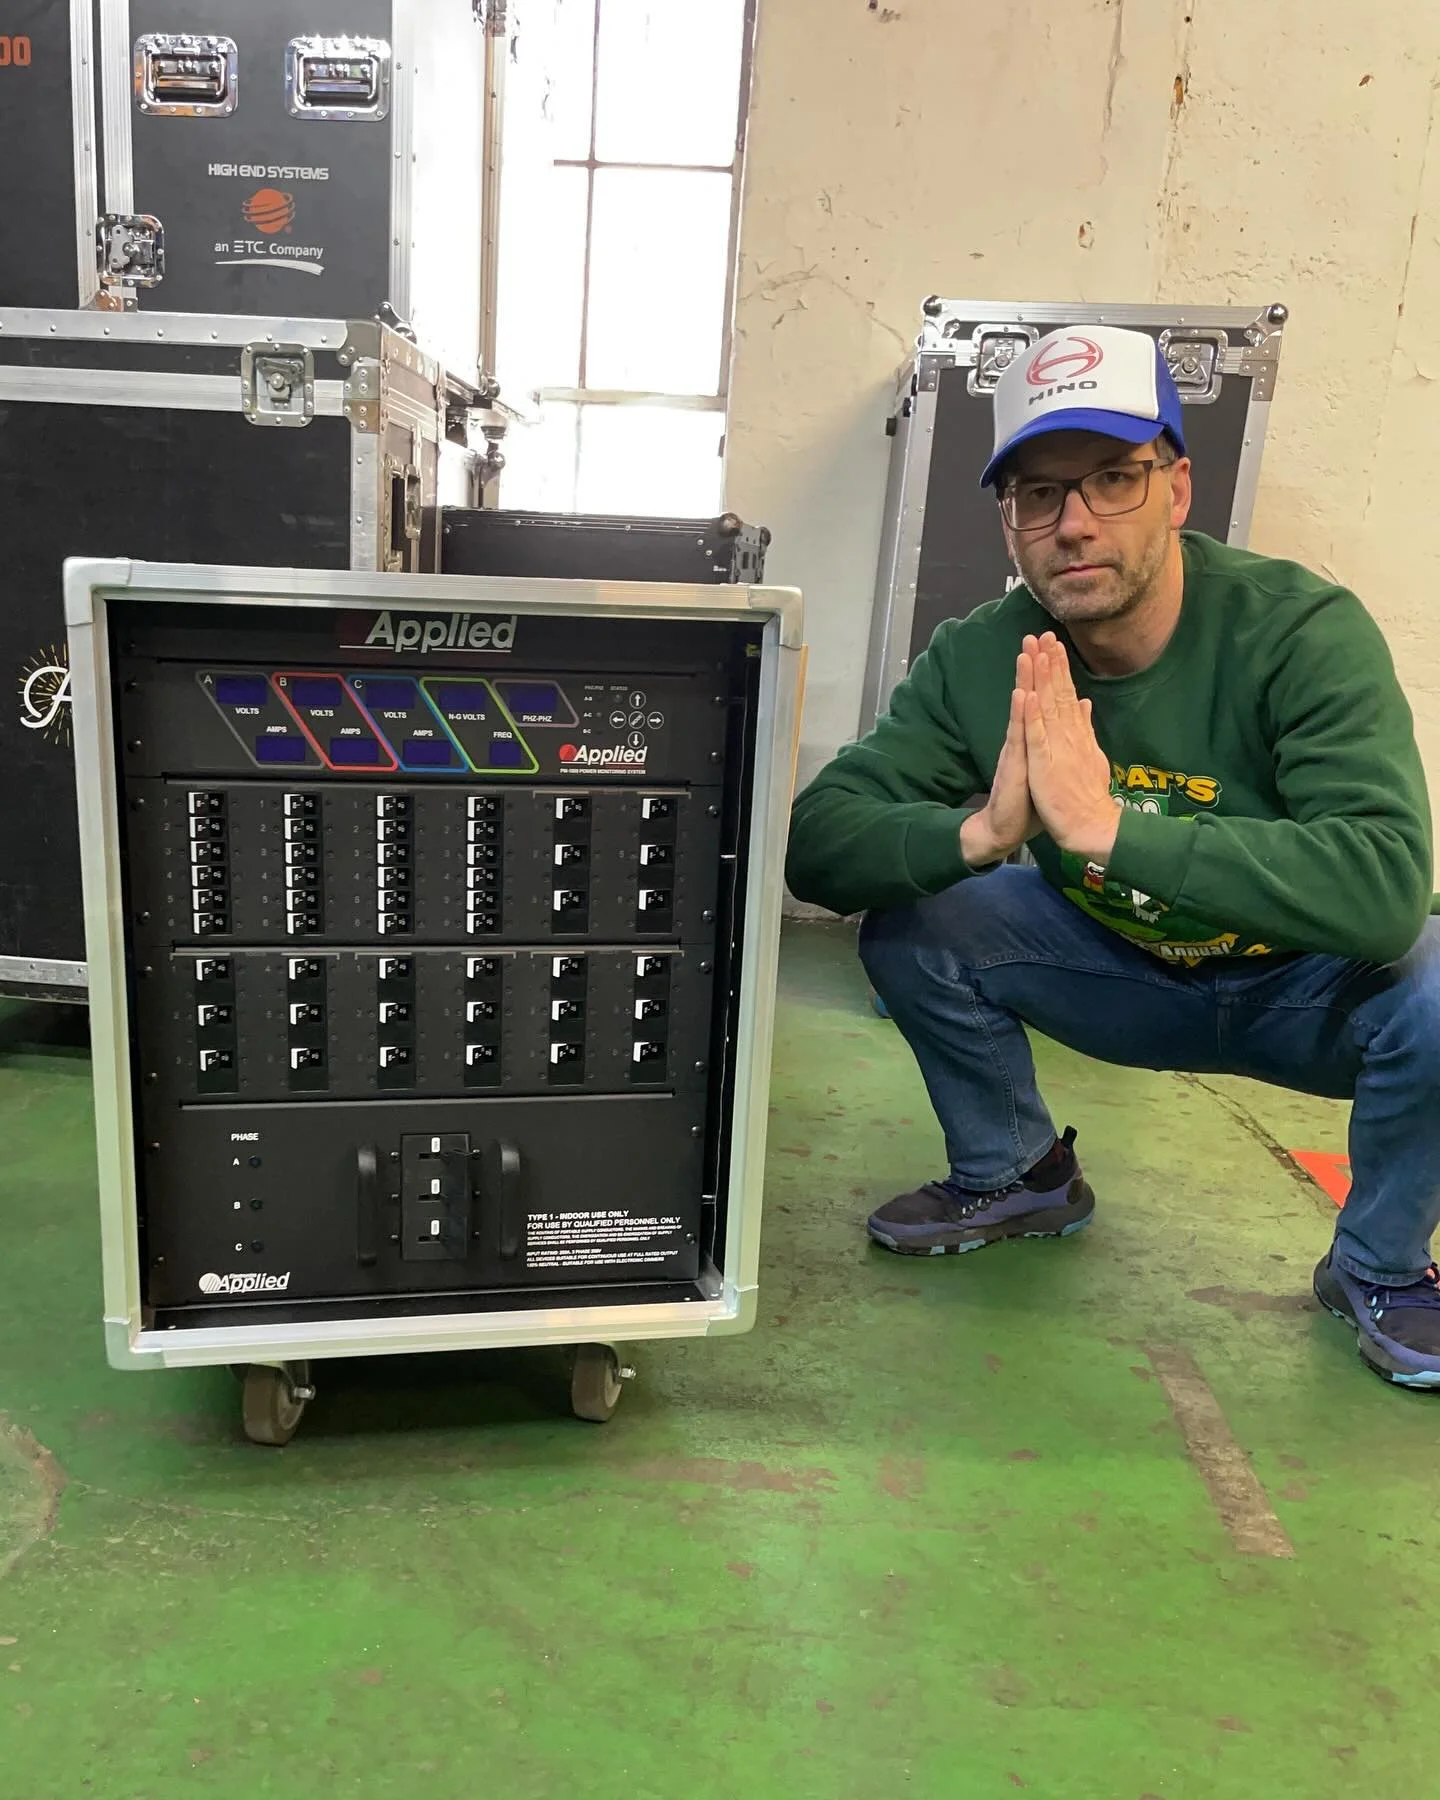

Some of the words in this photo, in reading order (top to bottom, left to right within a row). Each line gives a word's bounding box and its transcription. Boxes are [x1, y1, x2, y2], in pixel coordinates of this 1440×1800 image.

[208, 163, 238, 177] HIGH
[239, 165, 266, 178] END
[267, 166, 329, 180] SYSTEMS
[214, 242, 229, 253] an
[234, 240, 266, 254] ETC
[269, 243, 324, 260] Company
[1028, 380, 1098, 406] HINO
[365, 611, 518, 654] Applied
[204, 675, 213, 685] A
[280, 677, 287, 687] B
[354, 680, 362, 689] C
[235, 707, 260, 715] VOLTS
[310, 709, 334, 717] VOLTS
[383, 711, 407, 719] VOLTS
[463, 713, 486, 721] VOLTS
[340, 727, 361, 735] AMPS
[412, 729, 433, 737] AMPS
[493, 731, 512, 739] FREQ
[574, 745, 648, 766] Applied
[231, 1133, 259, 1141] PHASE
[232, 1158, 240, 1166] A
[233, 1201, 241, 1210] B
[528, 1213, 548, 1221] TYPE
[560, 1212, 590, 1220] INDOOR
[591, 1211, 607, 1219] USE
[608, 1210, 629, 1218] ONLY
[527, 1222, 544, 1230] FOR
[545, 1221, 560, 1229] USE
[562, 1220, 572, 1228] BY
[574, 1219, 613, 1228] QUALIFIED
[614, 1218, 659, 1226] PERSONNEL
[235, 1243, 243, 1251] C
[219, 1272, 291, 1294] Applied
